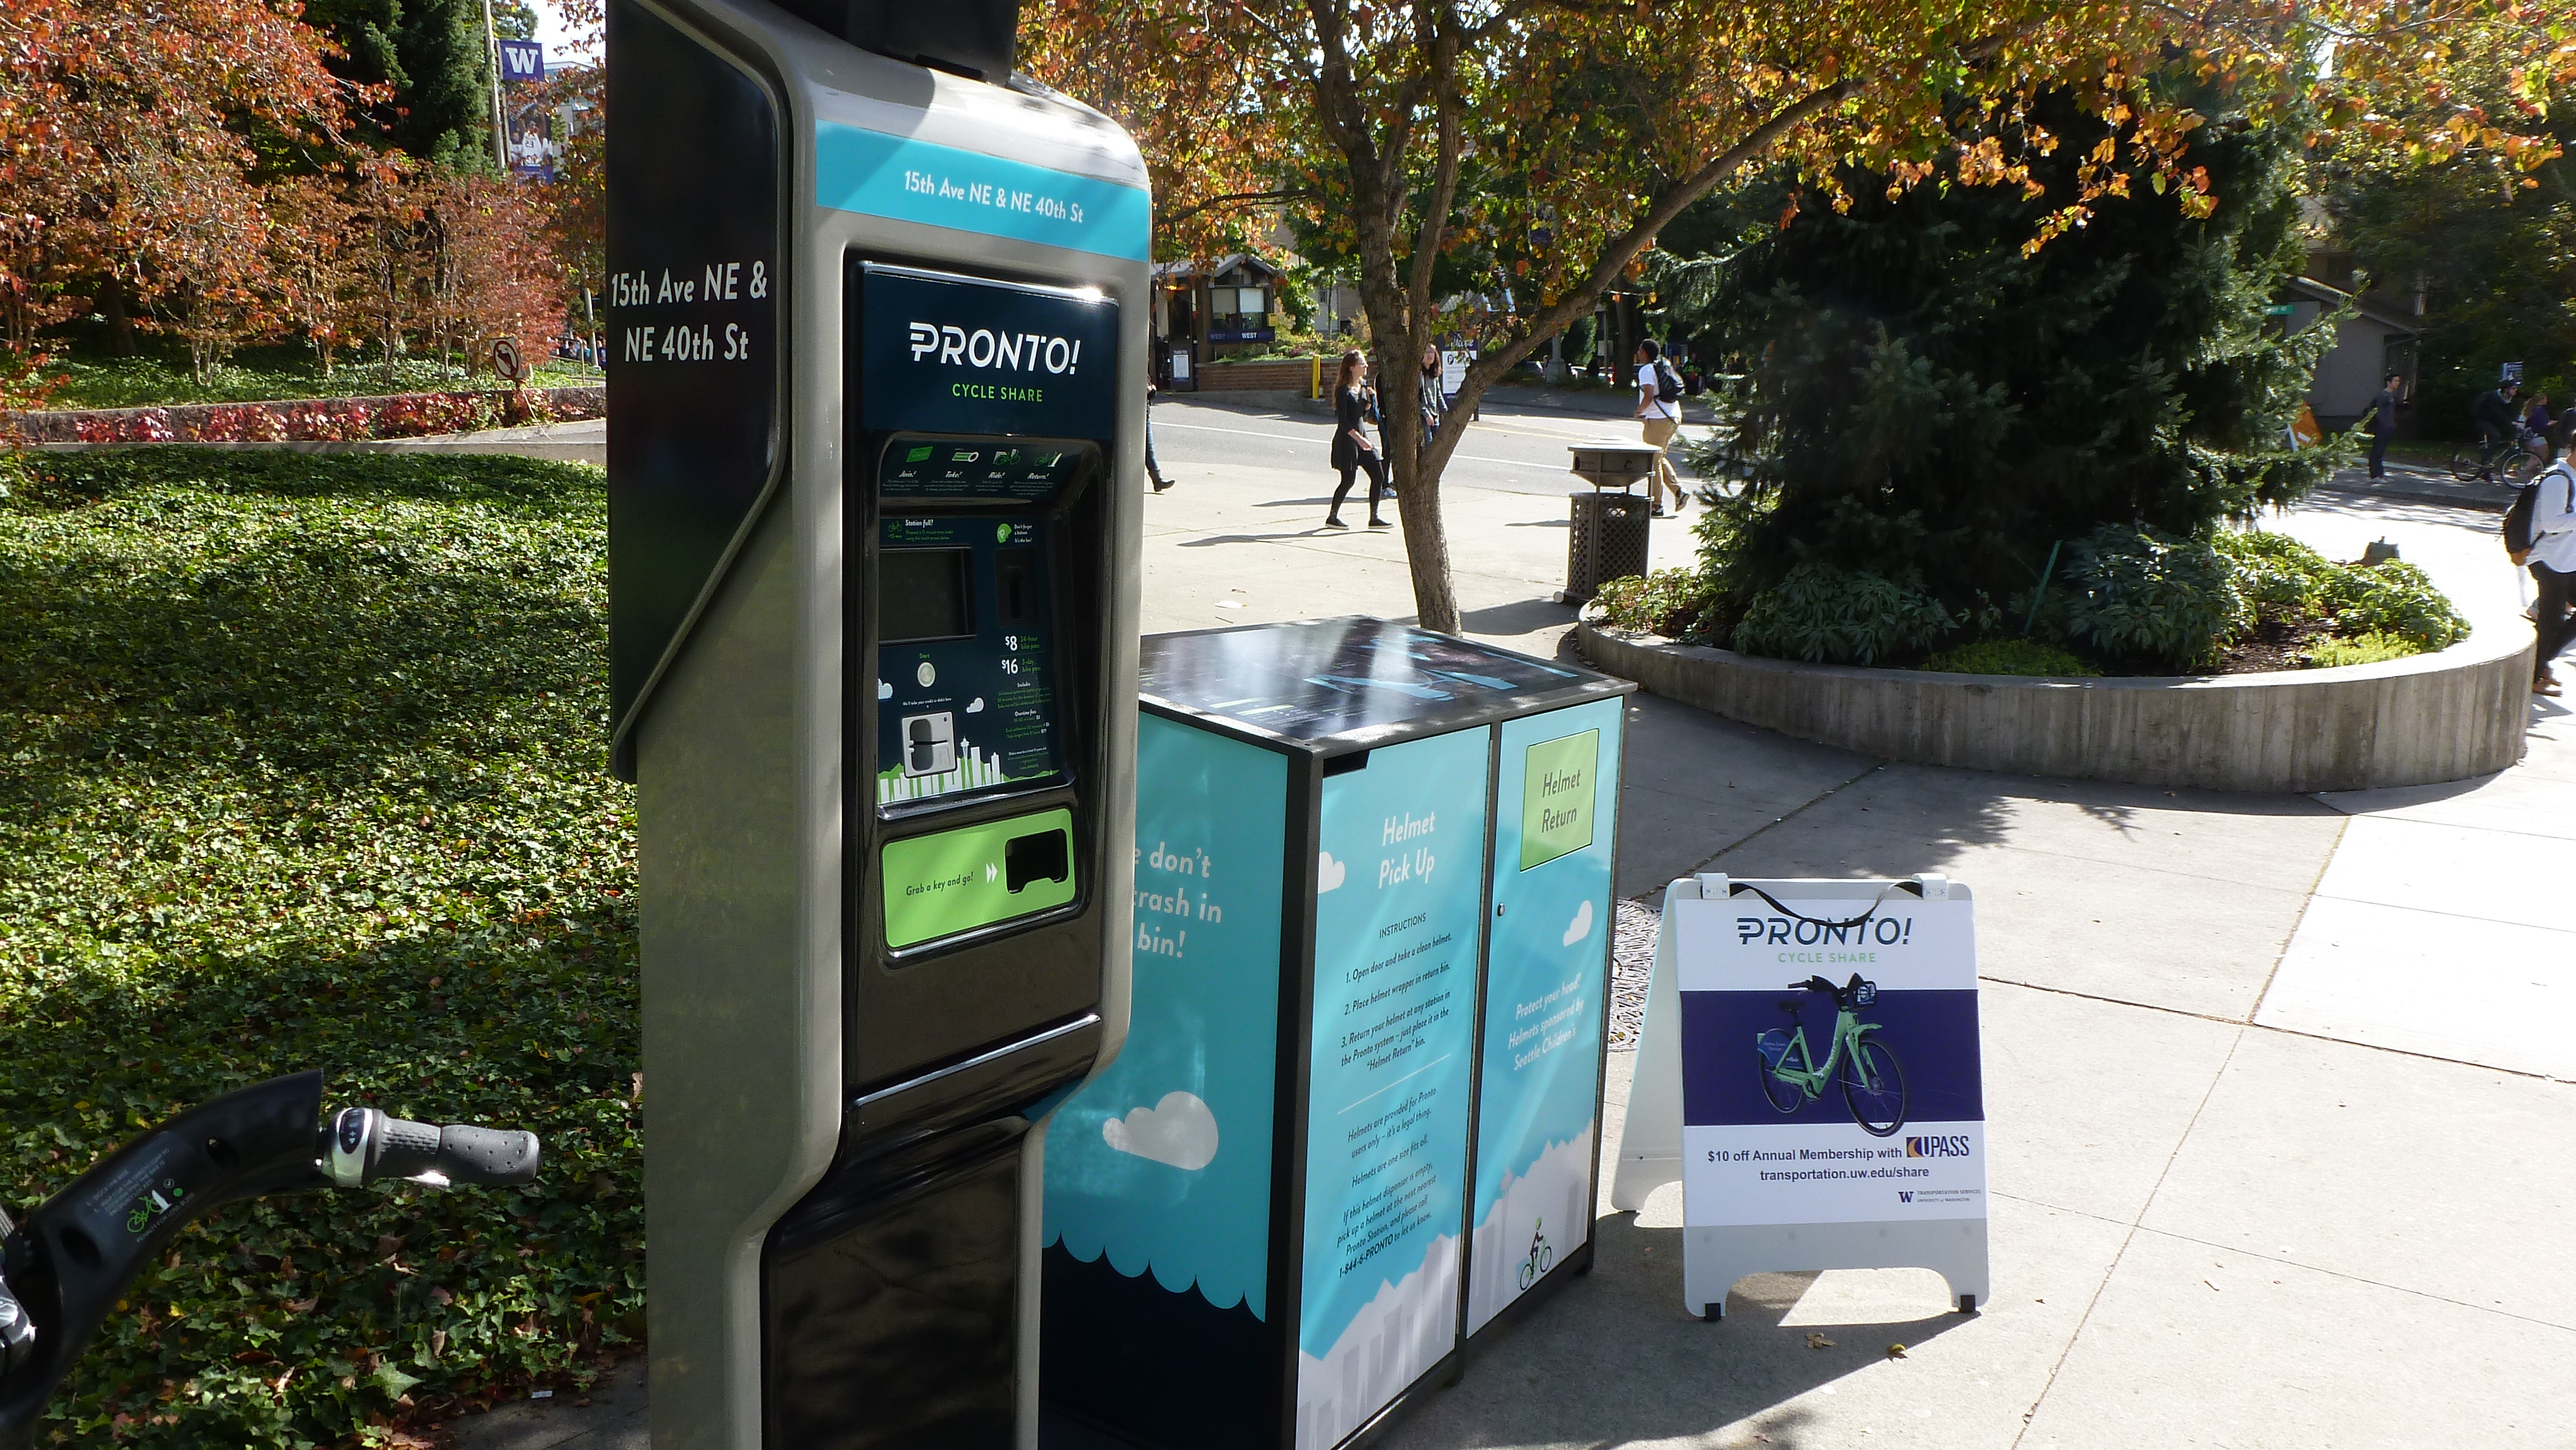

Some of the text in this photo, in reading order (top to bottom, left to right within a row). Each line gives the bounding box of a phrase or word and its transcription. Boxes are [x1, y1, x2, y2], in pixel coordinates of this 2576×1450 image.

[506, 47, 538, 74] W
[905, 171, 1083, 223] 15th Ave NE & NE 40th St
[611, 260, 767, 307] 15th Ave NE &
[625, 323, 748, 362] NE 40th St
[910, 322, 1080, 375] PRONTO!
[952, 383, 1043, 402] CYCLE SHARE
[922, 519, 934, 528] full?
[1005, 636, 1018, 651] $8
[1002, 658, 1019, 674] $16
[1542, 769, 1581, 798] Helmet
[1383, 811, 1436, 847] Helmet
[1541, 807, 1578, 833] Return
[1150, 841, 1210, 878] don't
[1379, 847, 1435, 889] Pick Up
[906, 883, 924, 896] Grab
[933, 880, 945, 892] key
[948, 874, 961, 887] and
[962, 871, 973, 886] go!
[1134, 887, 1221, 923] rash in
[1138, 922, 1185, 958] bin!
[1379, 912, 1426, 938] INSTRUCTIONS
[1736, 917, 1912, 946] PRONTO!
[1346, 972, 1351, 983] 1.
[1353, 968, 1369, 983] Open
[1371, 961, 1384, 972] door
[1385, 952, 1397, 966] and
[1398, 949, 1410, 962] take
[1416, 942, 1431, 954] clean
[1432, 933, 1452, 948] helmet.
[1778, 953, 1876, 963] CYCLE SHARE
[1345, 961, 1450, 1015] 2. Place helmet wrapper in return bin.
[1516, 996, 1543, 1020] Protect
[1543, 989, 1561, 1012] your
[1341, 989, 1450, 1048] 3. Return your helmet at any station in
[1342, 1054, 1351, 1066] the
[1353, 1045, 1373, 1061] Pronto
[1374, 1035, 1394, 1054] system
[1400, 1026, 1411, 1042] just
[1412, 1020, 1427, 1036] place
[1428, 1014, 1433, 1024] it
[1433, 1011, 1439, 1023] in
[1440, 1007, 1449, 1018] the
[1509, 997, 1584, 1049] Helmets sponsored by
[1415, 1036, 1425, 1048] bin.
[1514, 1023, 1576, 1071] Seattle Children's
[1348, 1088, 1436, 1142] Helmets are provided for Pronto
[1351, 1145, 1366, 1158] users
[1368, 1134, 1380, 1148] only
[1401, 1113, 1415, 1130] legal
[1352, 1168, 1376, 1188] Helmets
[1377, 1162, 1386, 1172] are
[1388, 1155, 1398, 1166] one
[1400, 1148, 1409, 1159] size
[1410, 1141, 1419, 1157] fits
[1708, 1150, 1729, 1163] $10
[1733, 1150, 1750, 1162] off
[1753, 1150, 1796, 1161] Annual
[1800, 1148, 1874, 1161] Membership
[1877, 1147, 1902, 1158] with
[1760, 1167, 1930, 1182] transportation.uw.edu/share
[1337, 1228, 1350, 1248] pick
[1352, 1225, 1359, 1237] up
[1366, 1207, 1385, 1226] helmet
[1386, 1203, 1392, 1213] at
[1394, 1197, 1403, 1208] the
[1404, 1188, 1416, 1201] next
[1417, 1174, 1436, 1193] nearest
[1343, 1209, 1351, 1225] If
[1349, 1204, 1361, 1219] this
[1362, 1192, 1382, 1211] helmet
[1383, 1176, 1408, 1197] dispenser
[1410, 1173, 1414, 1181] is
[1898, 1191, 1914, 1203] W
[1346, 1238, 1366, 1256] Pronto
[1390, 1212, 1401, 1227] and
[1401, 1204, 1417, 1224] please
[1419, 1194, 1428, 1209] call
[1339, 1234, 1393, 1278] 1-844-6-PRONTO
[1394, 1232, 1400, 1241] to
[1410, 1222, 1416, 1231] us
